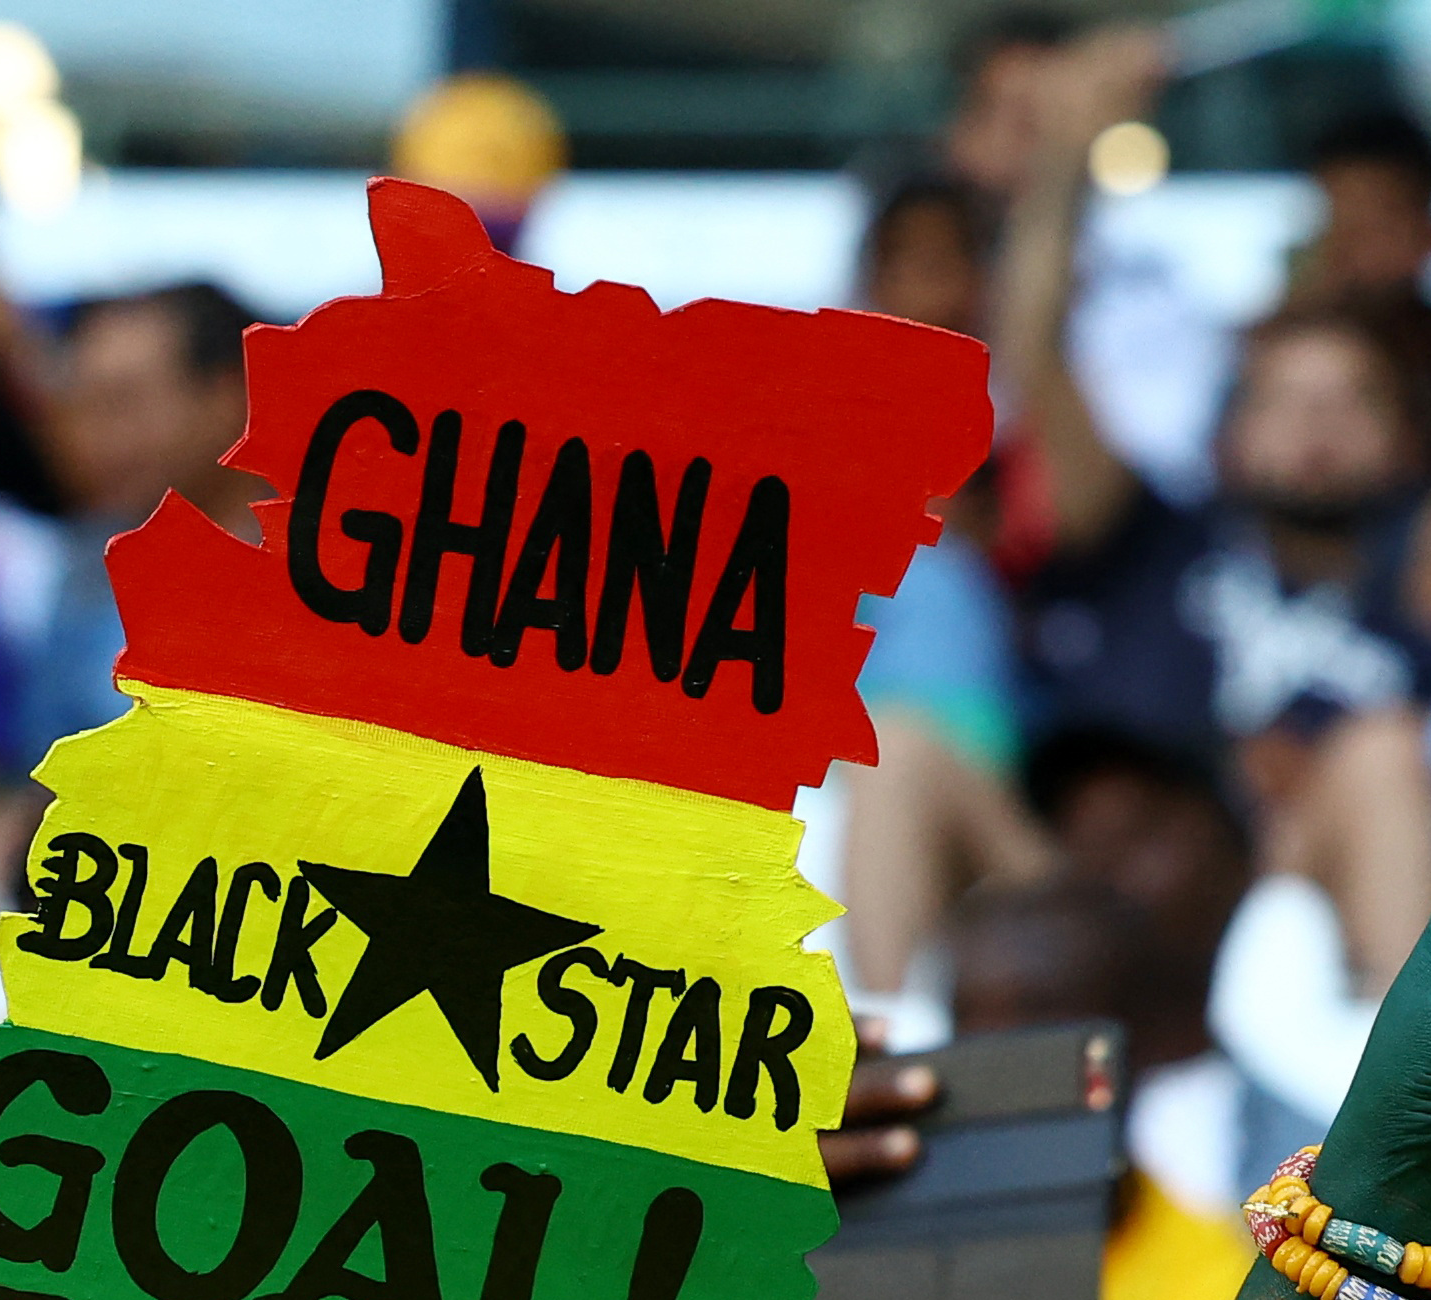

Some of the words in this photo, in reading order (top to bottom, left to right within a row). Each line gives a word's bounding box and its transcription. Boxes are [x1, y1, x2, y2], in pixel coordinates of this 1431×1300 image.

[287, 389, 790, 714] GHANA
[17, 832, 337, 1018] BLACK
[510, 947, 814, 1131] STAR
